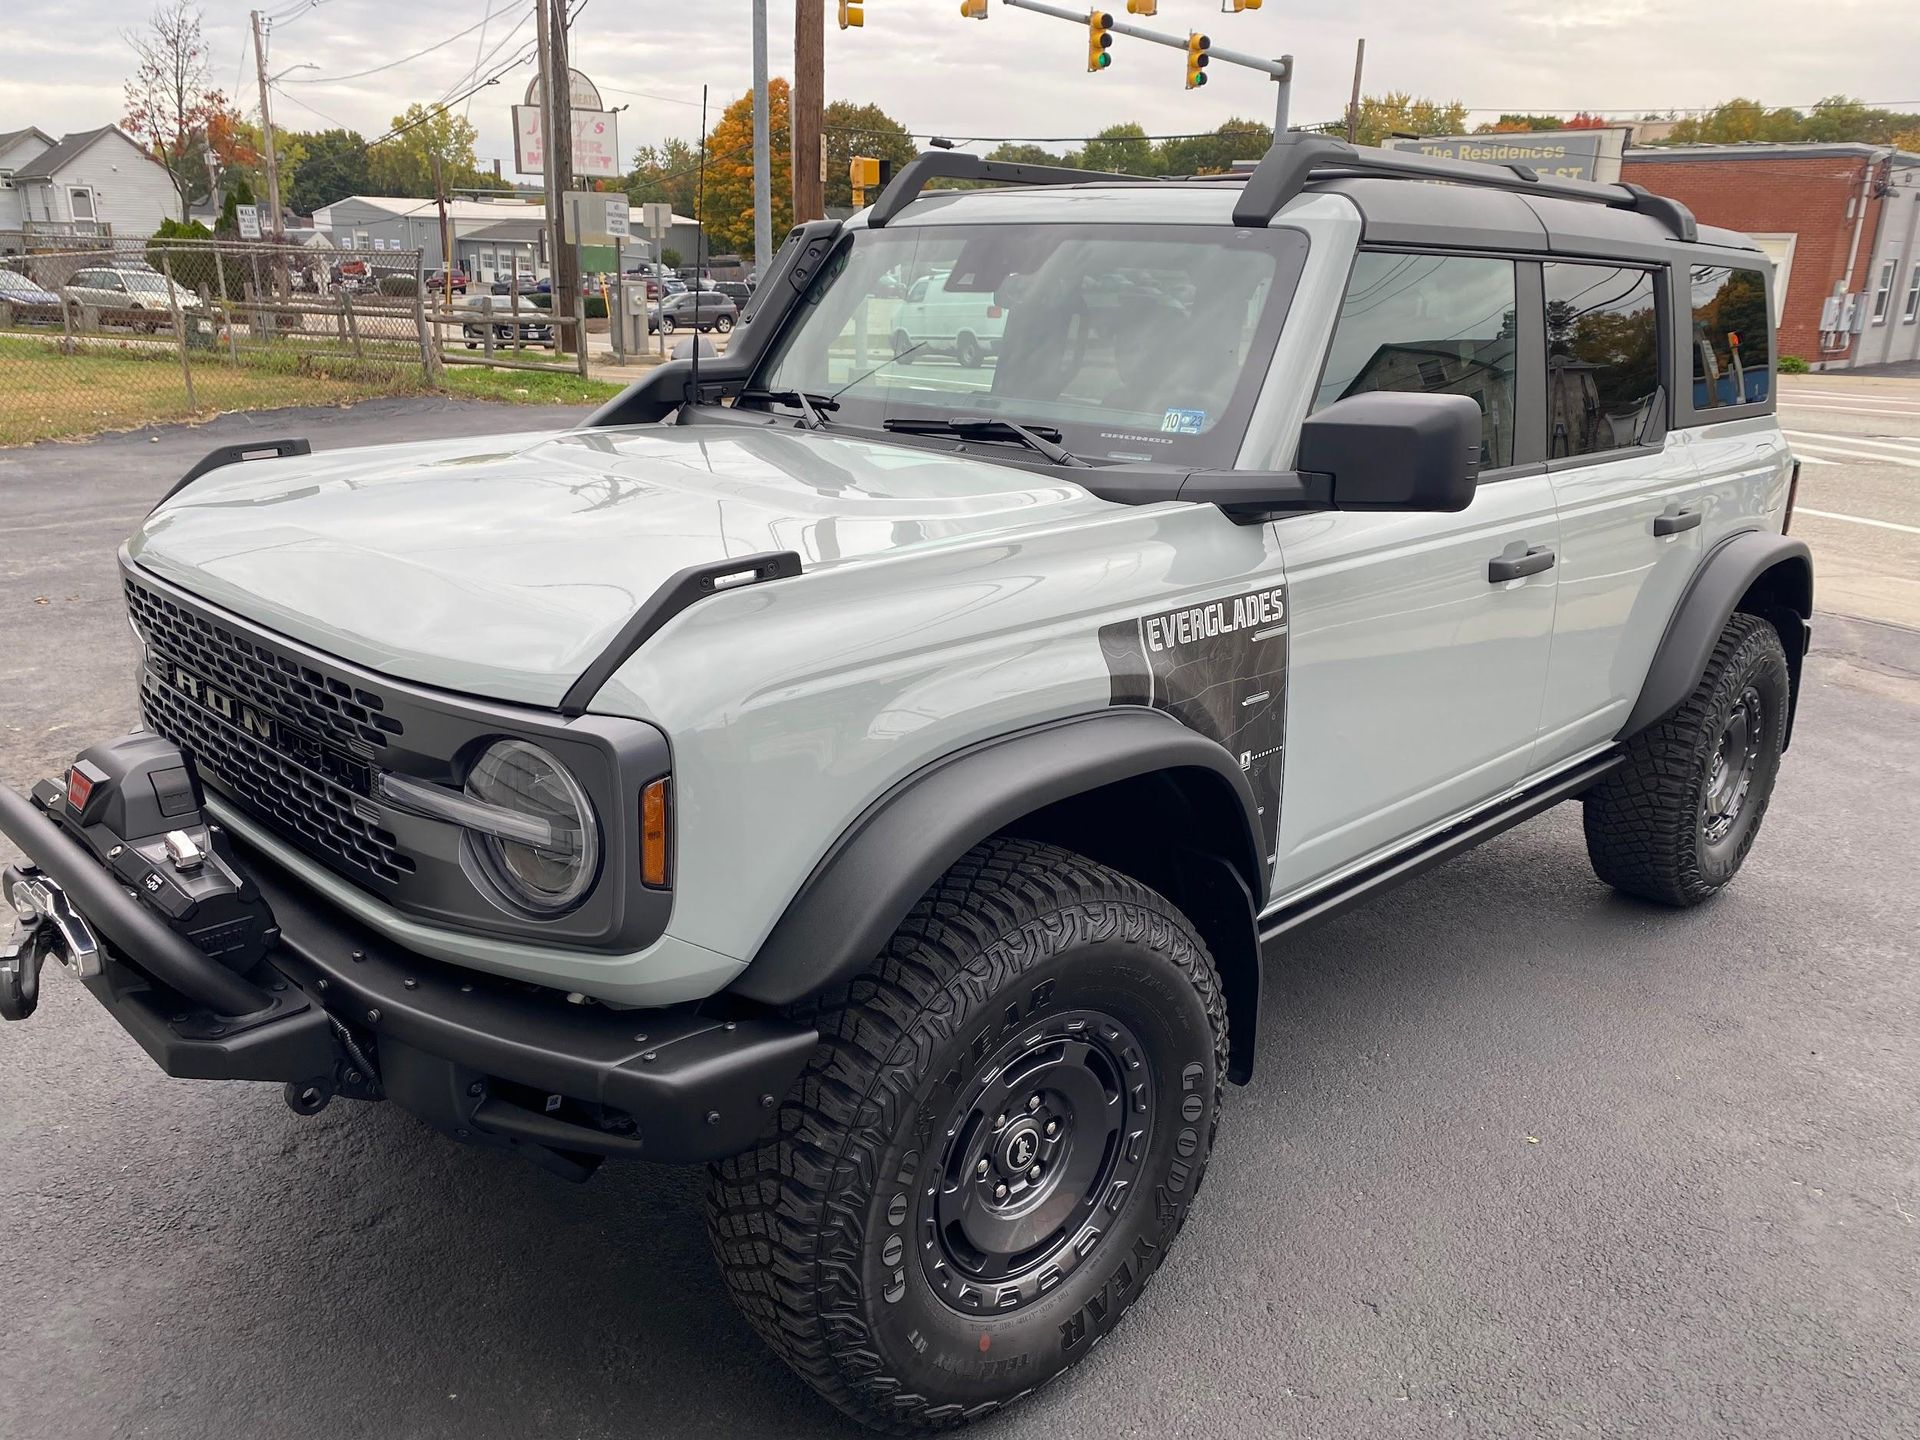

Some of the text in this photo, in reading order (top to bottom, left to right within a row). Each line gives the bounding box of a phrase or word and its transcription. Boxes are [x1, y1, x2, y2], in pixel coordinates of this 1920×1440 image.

[527, 151, 612, 169] MKET
[1420, 144, 1565, 161] The Residences
[1165, 413, 1179, 429] 10
[1146, 588, 1284, 652] EVERGLADES
